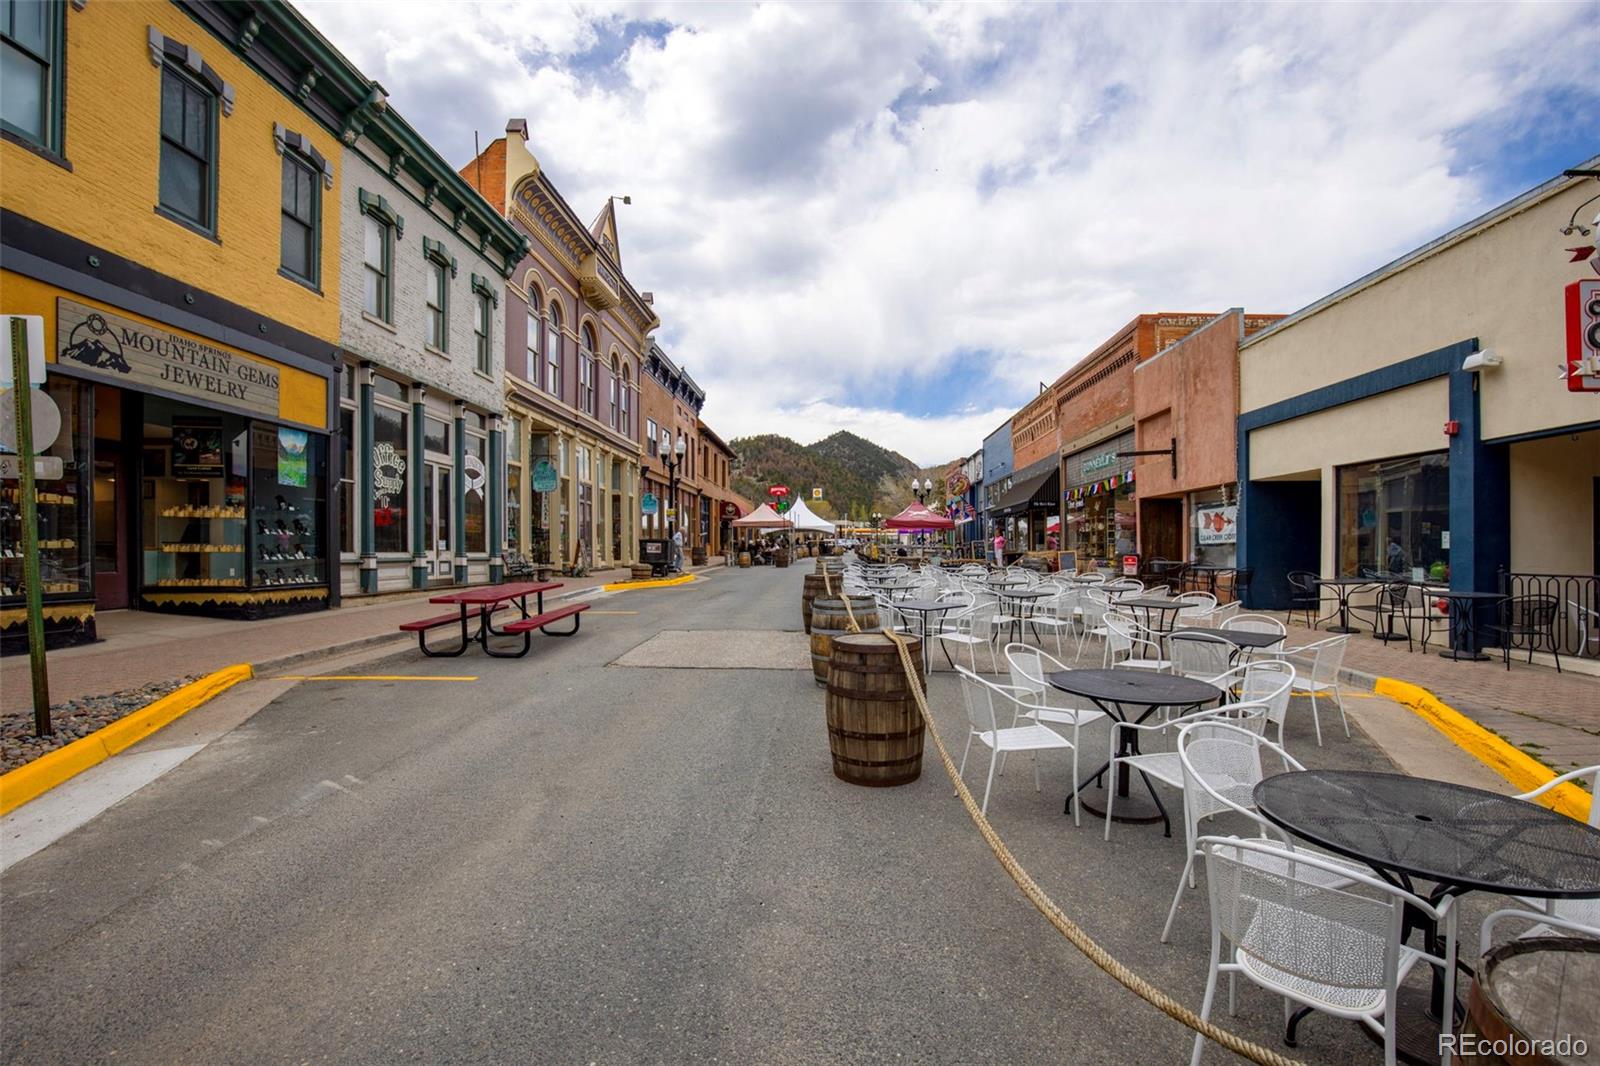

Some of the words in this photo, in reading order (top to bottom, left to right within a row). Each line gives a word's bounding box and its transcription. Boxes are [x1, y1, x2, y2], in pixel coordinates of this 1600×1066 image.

[121, 327, 230, 375] MOUNTAIN
[237, 364, 279, 389] GEMS
[169, 334, 197, 350] IDAHO
[198, 343, 232, 360] SPRINGS
[160, 363, 249, 400] JEWELRY
